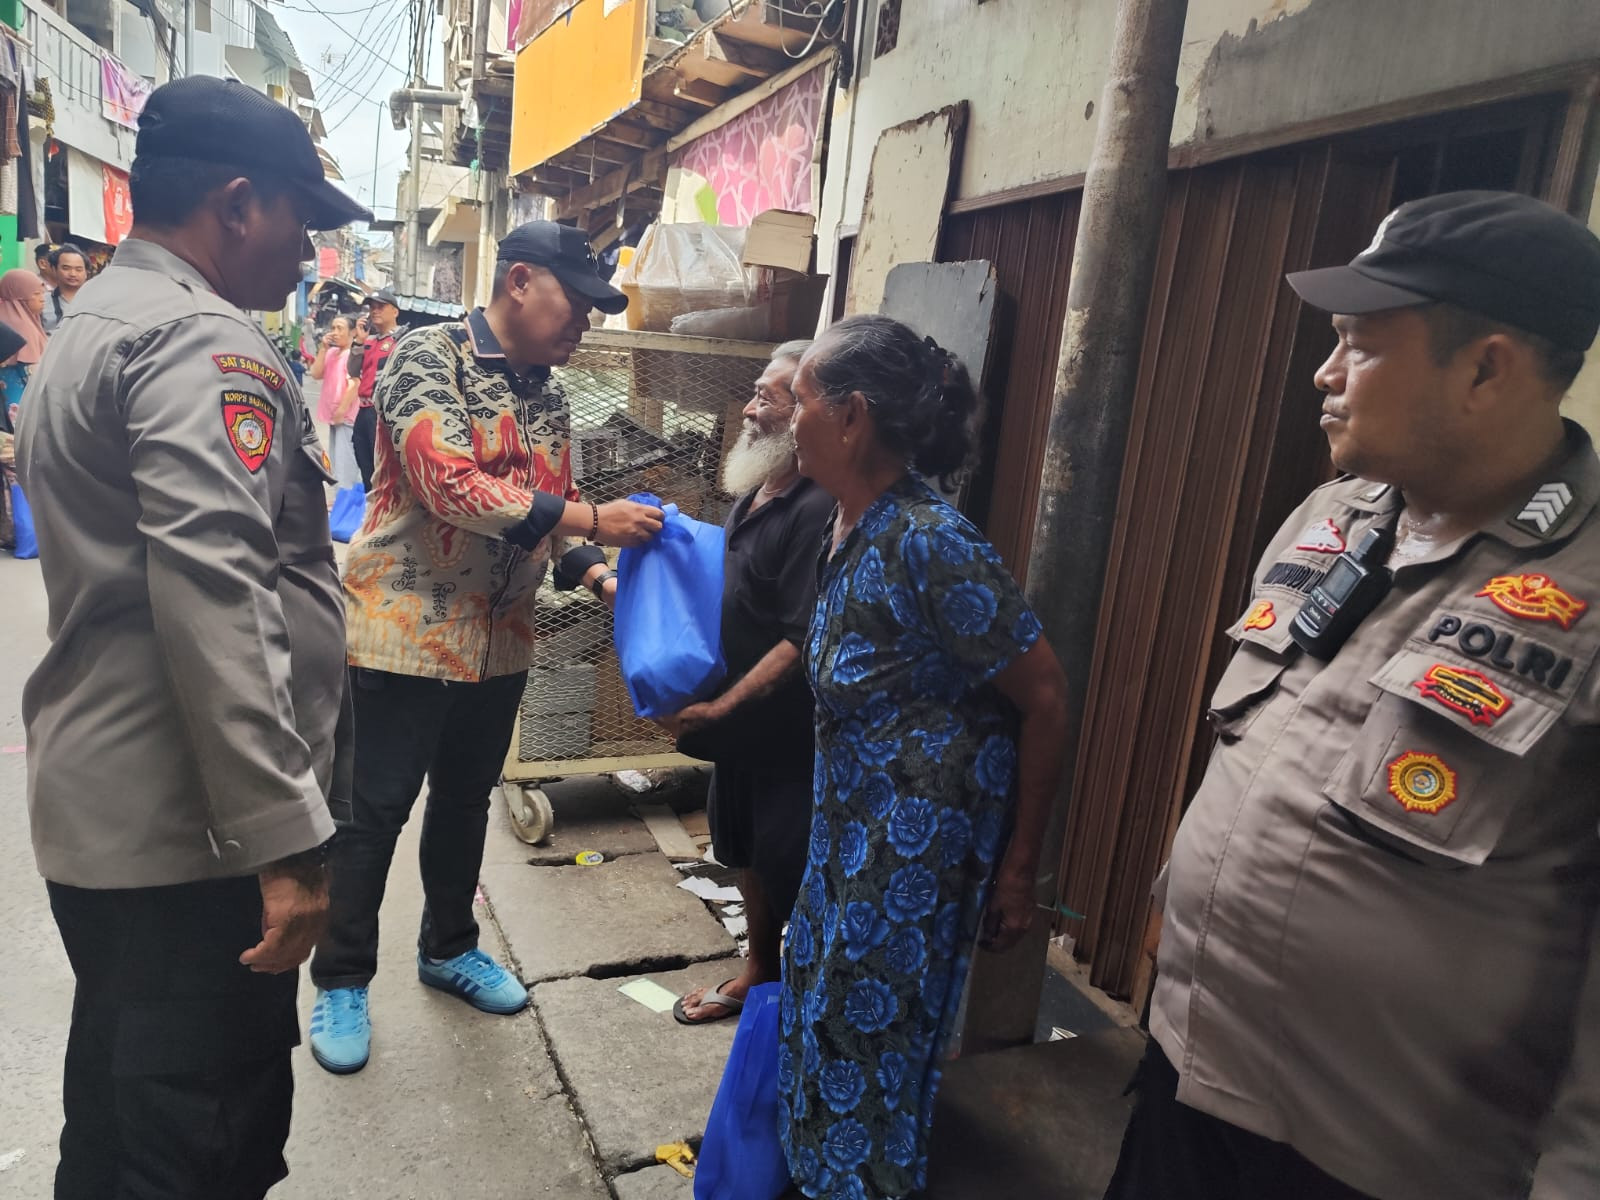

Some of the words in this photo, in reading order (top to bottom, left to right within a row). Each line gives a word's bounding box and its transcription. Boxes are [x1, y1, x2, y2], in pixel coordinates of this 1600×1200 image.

[220, 357, 237, 367] SAT
[240, 359, 279, 385] SAMAPTA
[224, 393, 248, 403] KORPS
[1428, 614, 1573, 690] POLRI
